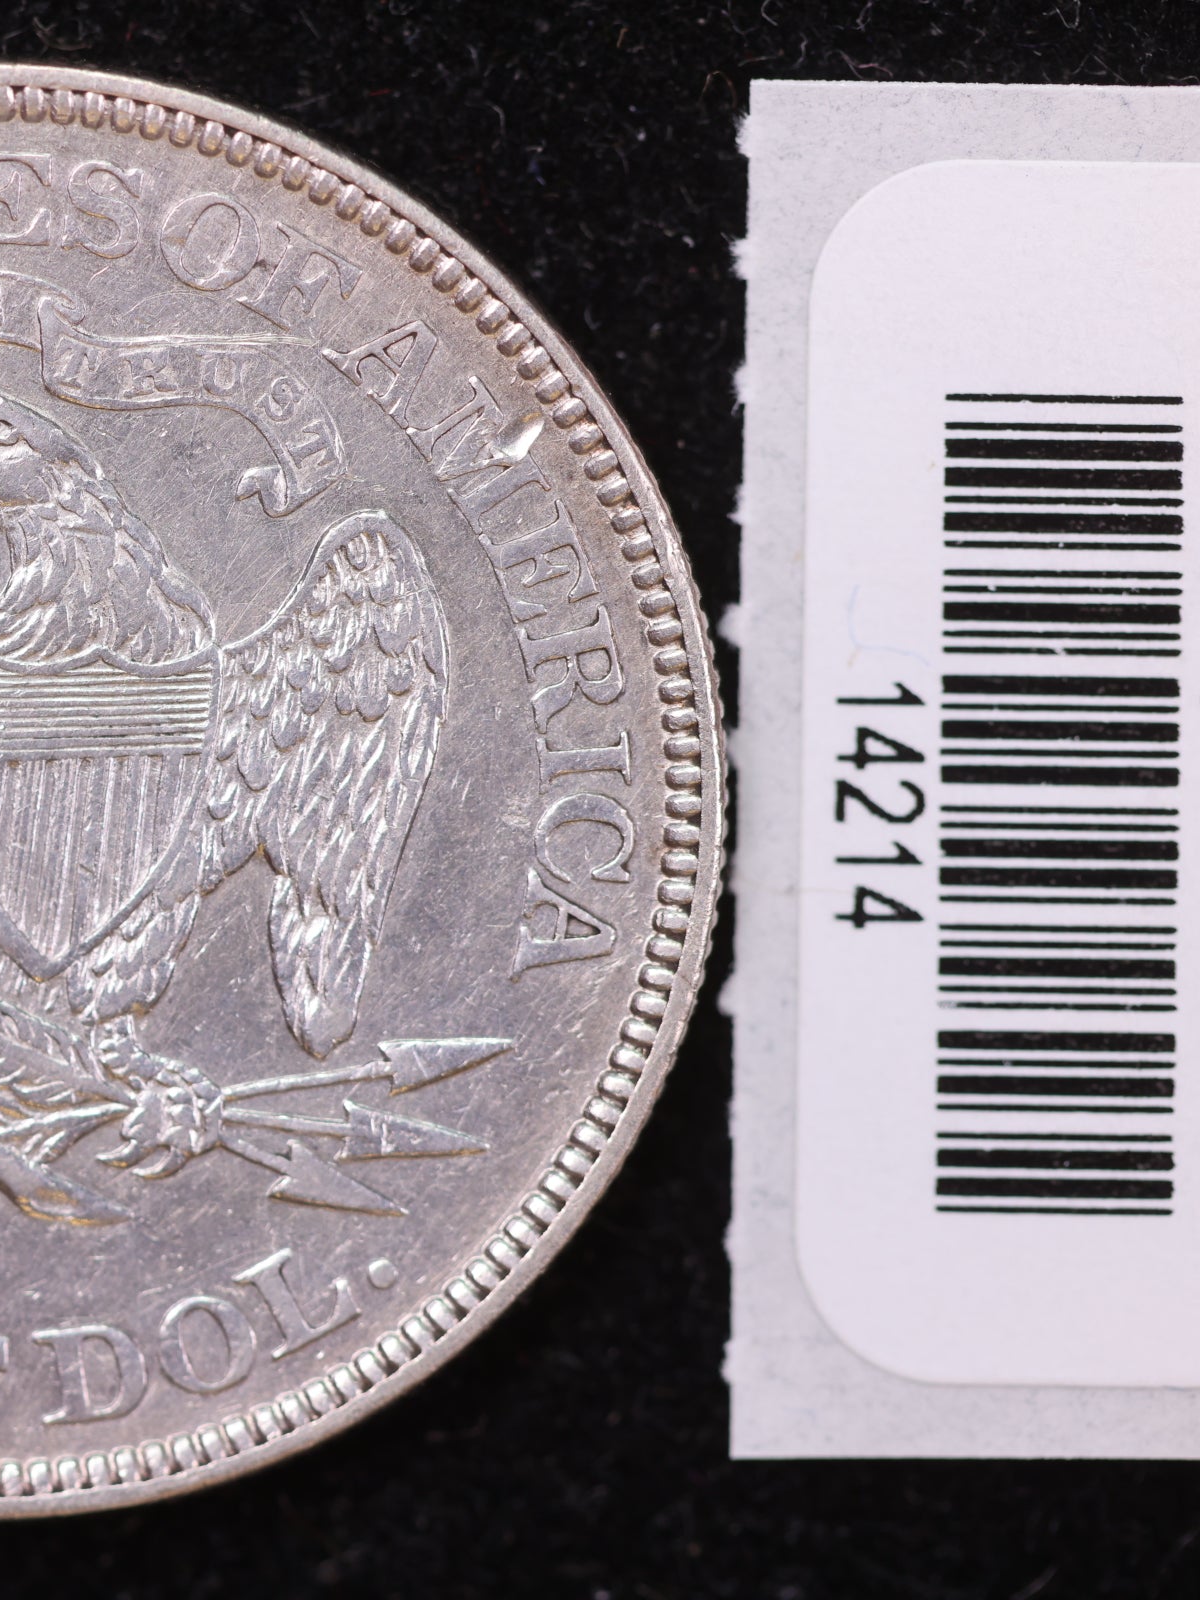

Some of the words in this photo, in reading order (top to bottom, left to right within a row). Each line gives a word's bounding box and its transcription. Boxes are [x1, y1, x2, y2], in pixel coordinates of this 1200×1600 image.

[52, 336, 338, 474] TRUST
[158, 191, 364, 332] OF
[320, 318, 639, 982] AMERICA
[834, 680, 927, 930] 14214
